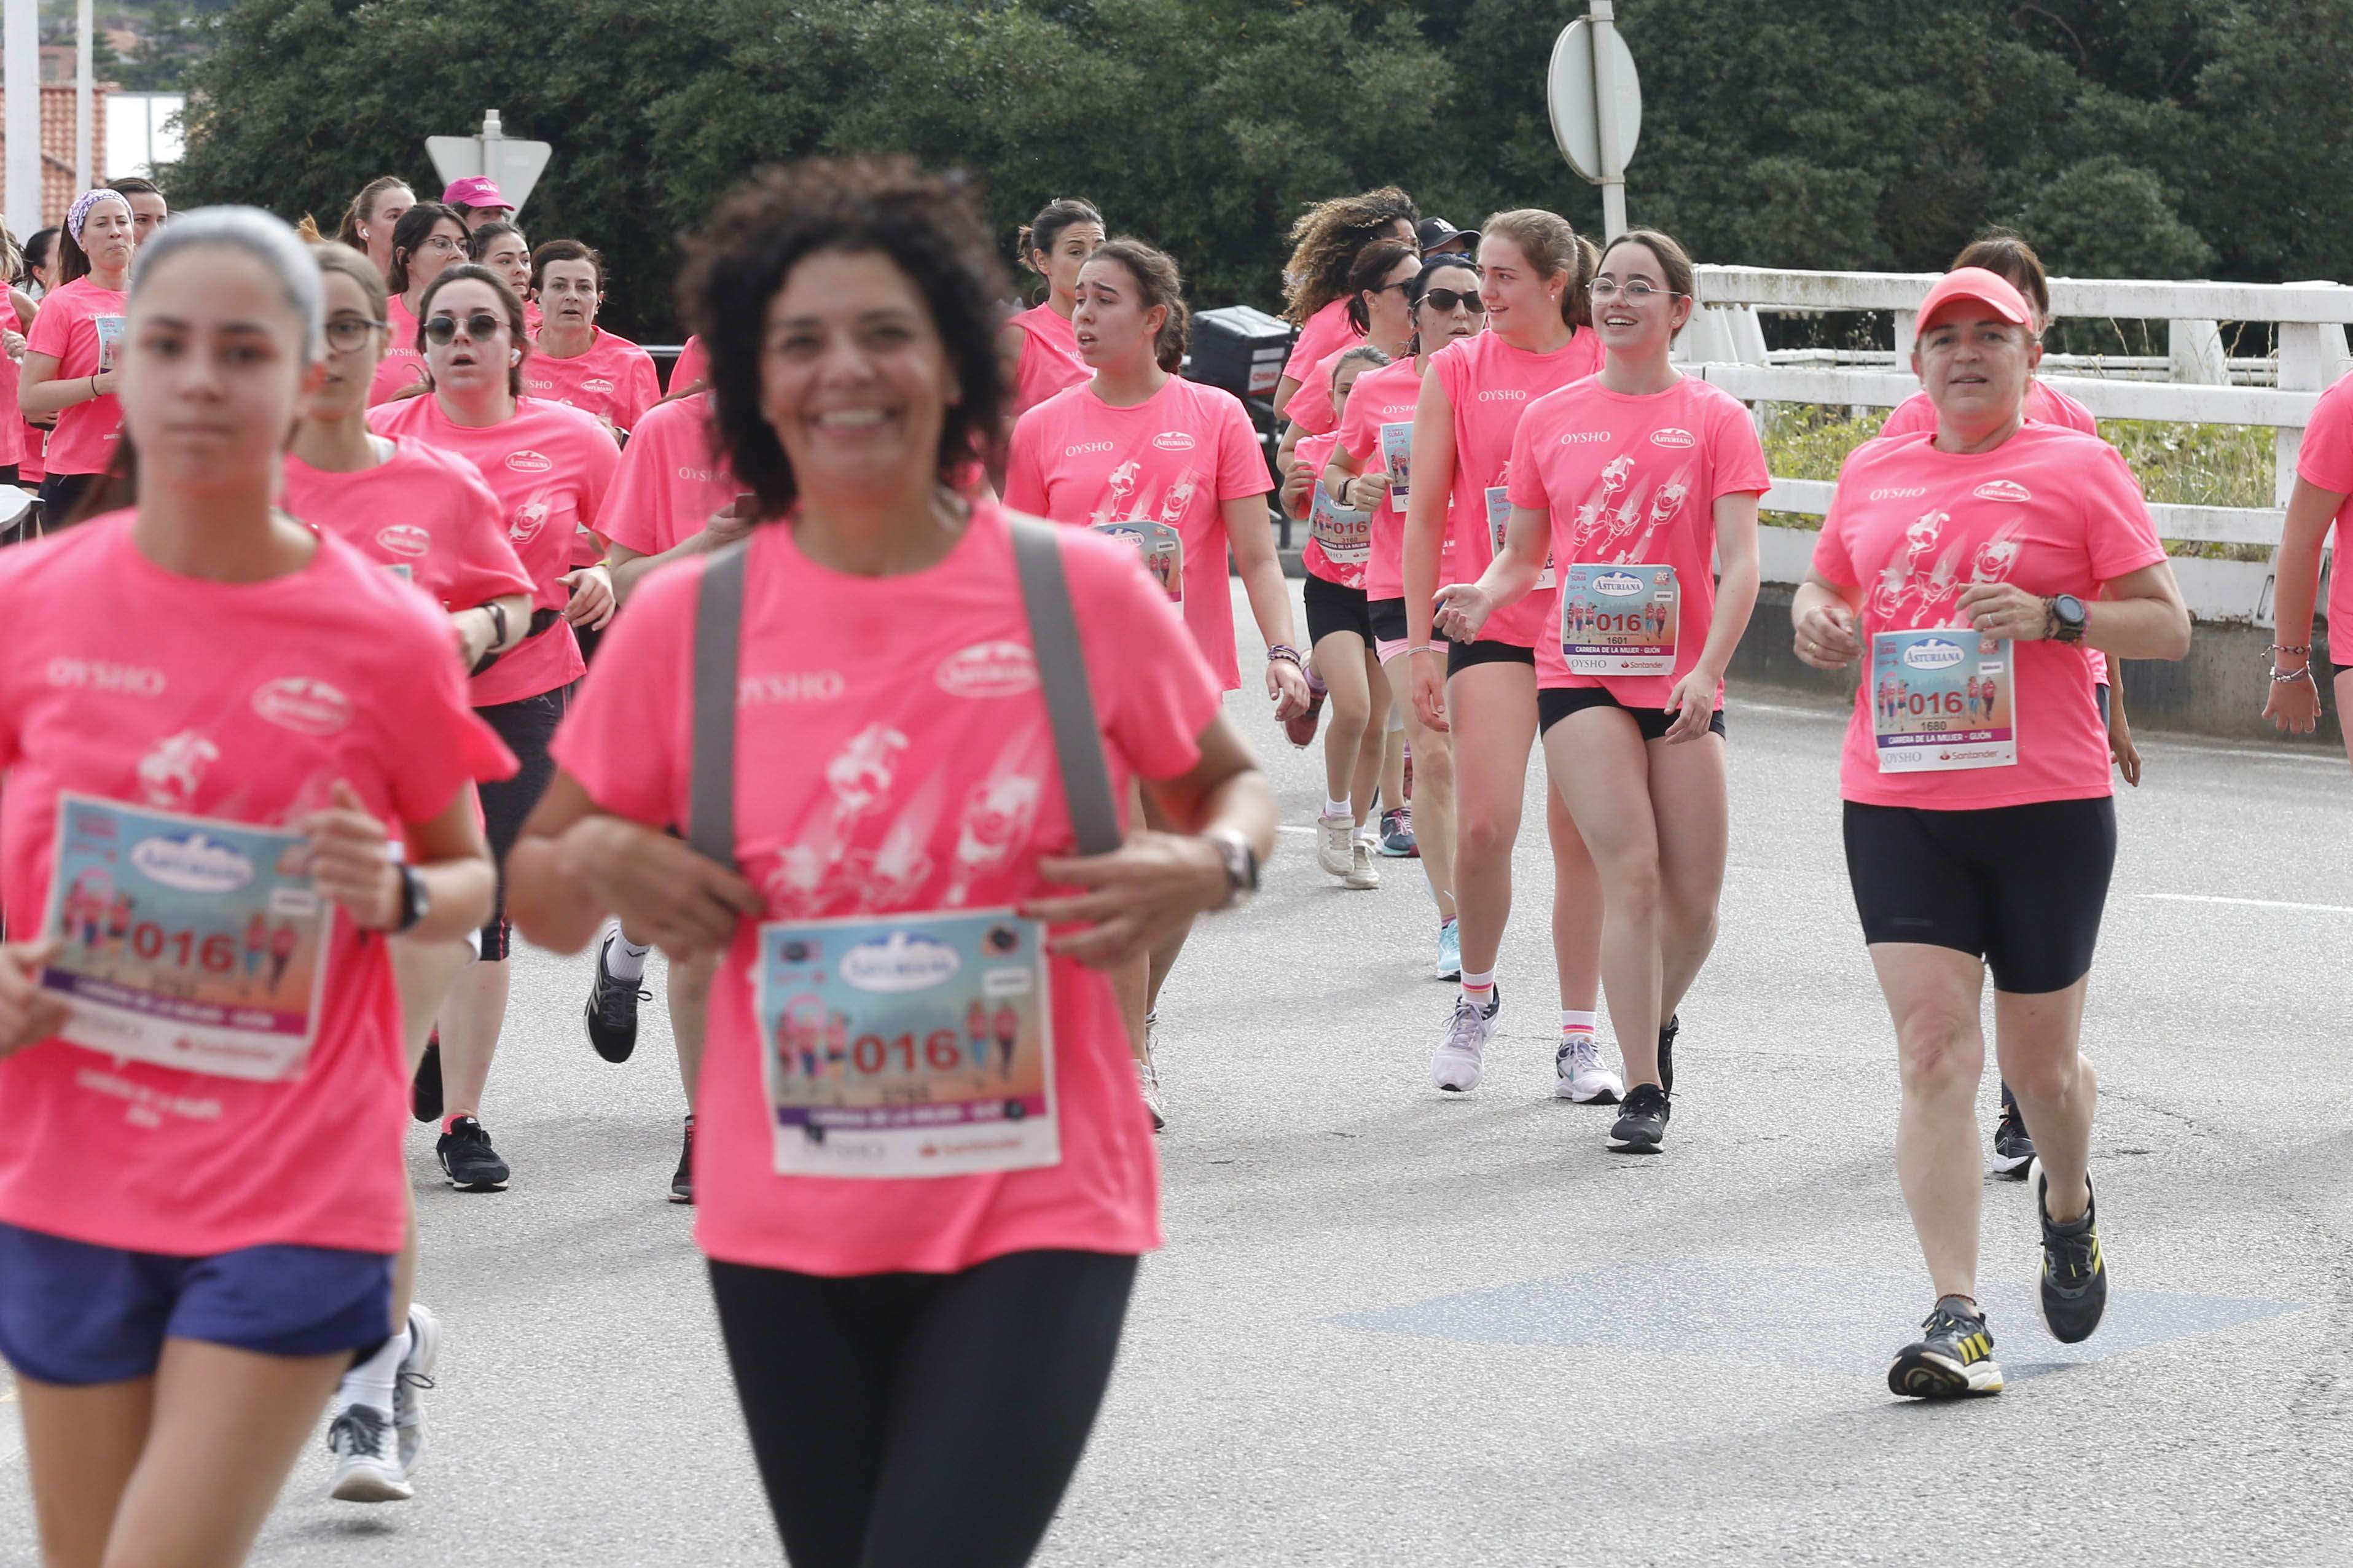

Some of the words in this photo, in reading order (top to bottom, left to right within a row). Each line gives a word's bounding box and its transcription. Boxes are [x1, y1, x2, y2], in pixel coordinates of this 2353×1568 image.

[1478, 389, 1527, 402] OYSHO
[1561, 431, 1611, 445] OYSHO
[1654, 434, 1692, 445] ASTURIANA
[1065, 441, 1114, 457] OYSHO
[1869, 487, 1927, 502] OYSHO
[1334, 521, 1368, 534] 016
[1595, 580, 1640, 590] ASTURIANA
[1596, 614, 1642, 631] 016
[1607, 636, 1627, 645] 1601
[1571, 659, 1607, 668] OYSHO
[1906, 651, 1960, 663] ASTURIANA
[1909, 692, 1963, 715] 016
[1886, 751, 1922, 763] OYSHO
[1952, 751, 1999, 760] Santander
[132, 919, 236, 974] 016
[852, 1028, 962, 1075] 016
